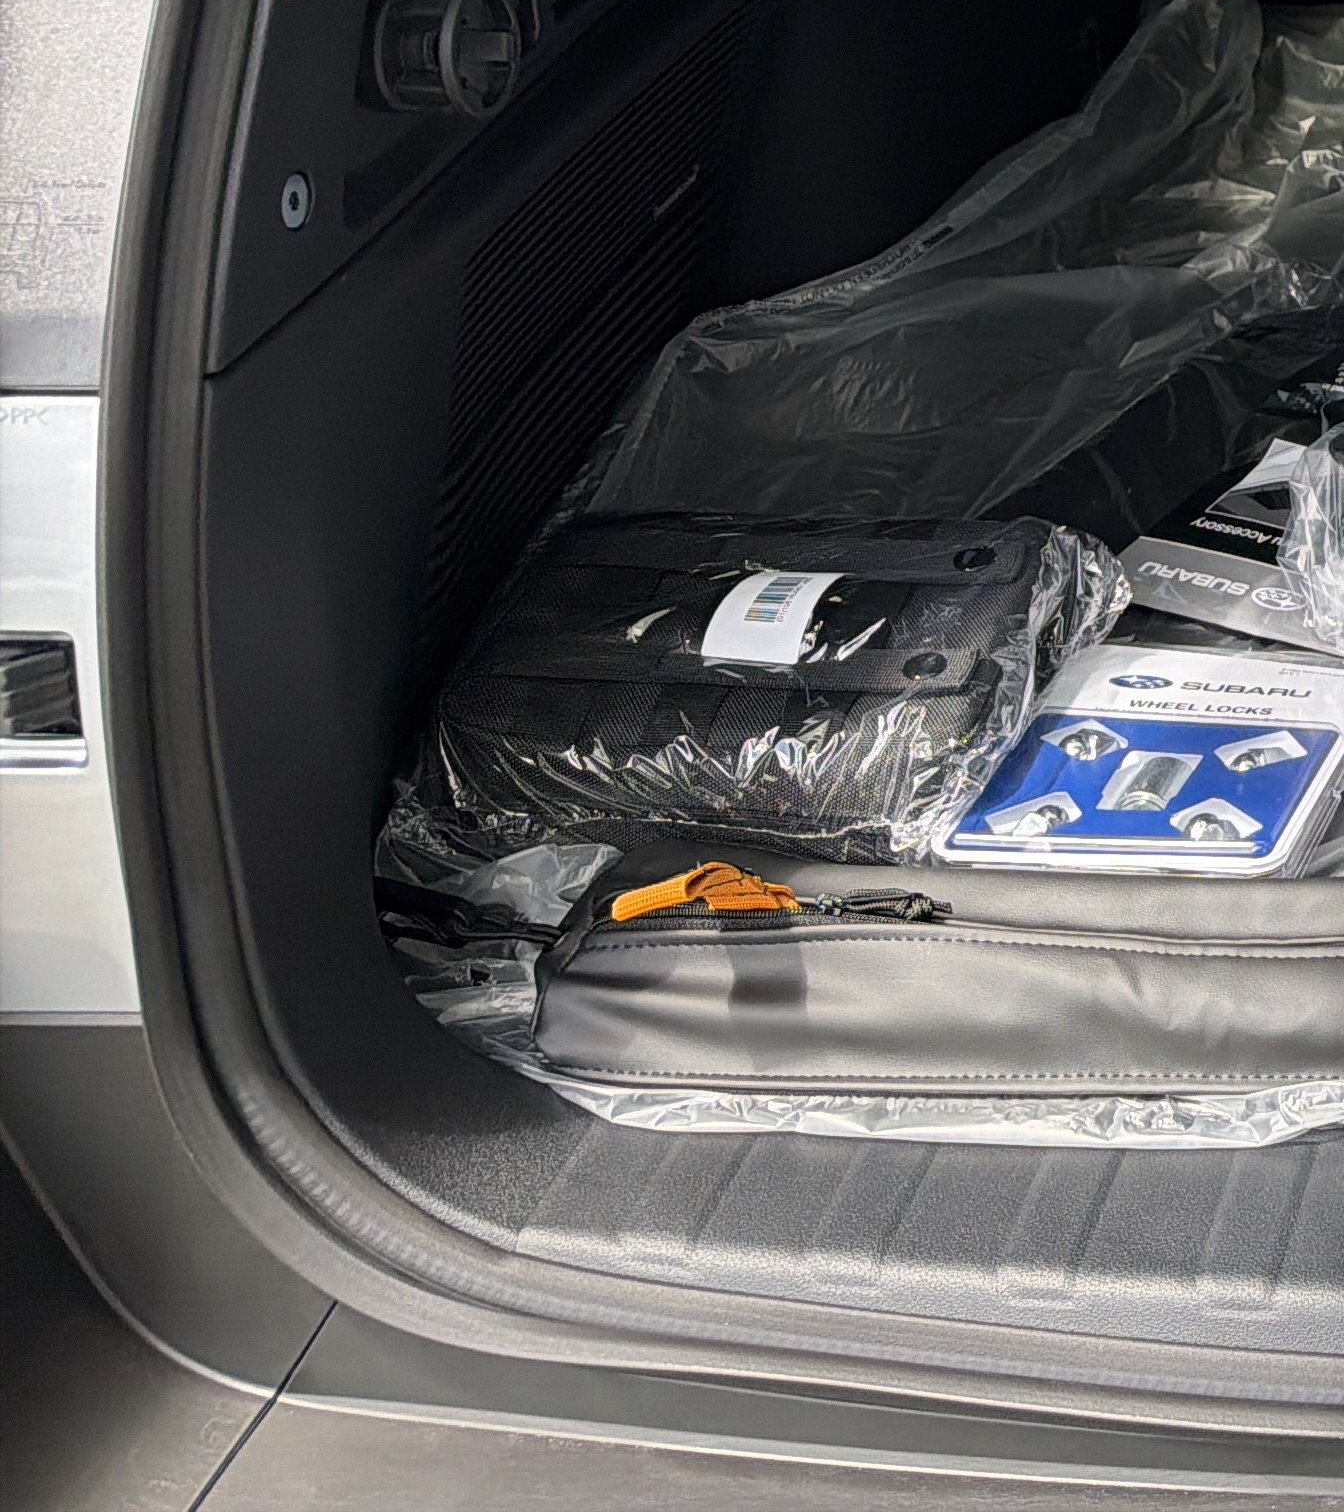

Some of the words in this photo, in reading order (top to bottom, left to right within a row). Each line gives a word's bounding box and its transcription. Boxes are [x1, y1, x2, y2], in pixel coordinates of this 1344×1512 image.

[1189, 517, 1272, 545] Accessory
[1137, 561, 1250, 596] SUBARU
[1179, 680, 1313, 698] SUBARU
[1129, 698, 1198, 712] WHEEL
[1202, 703, 1274, 716] LOCKS
